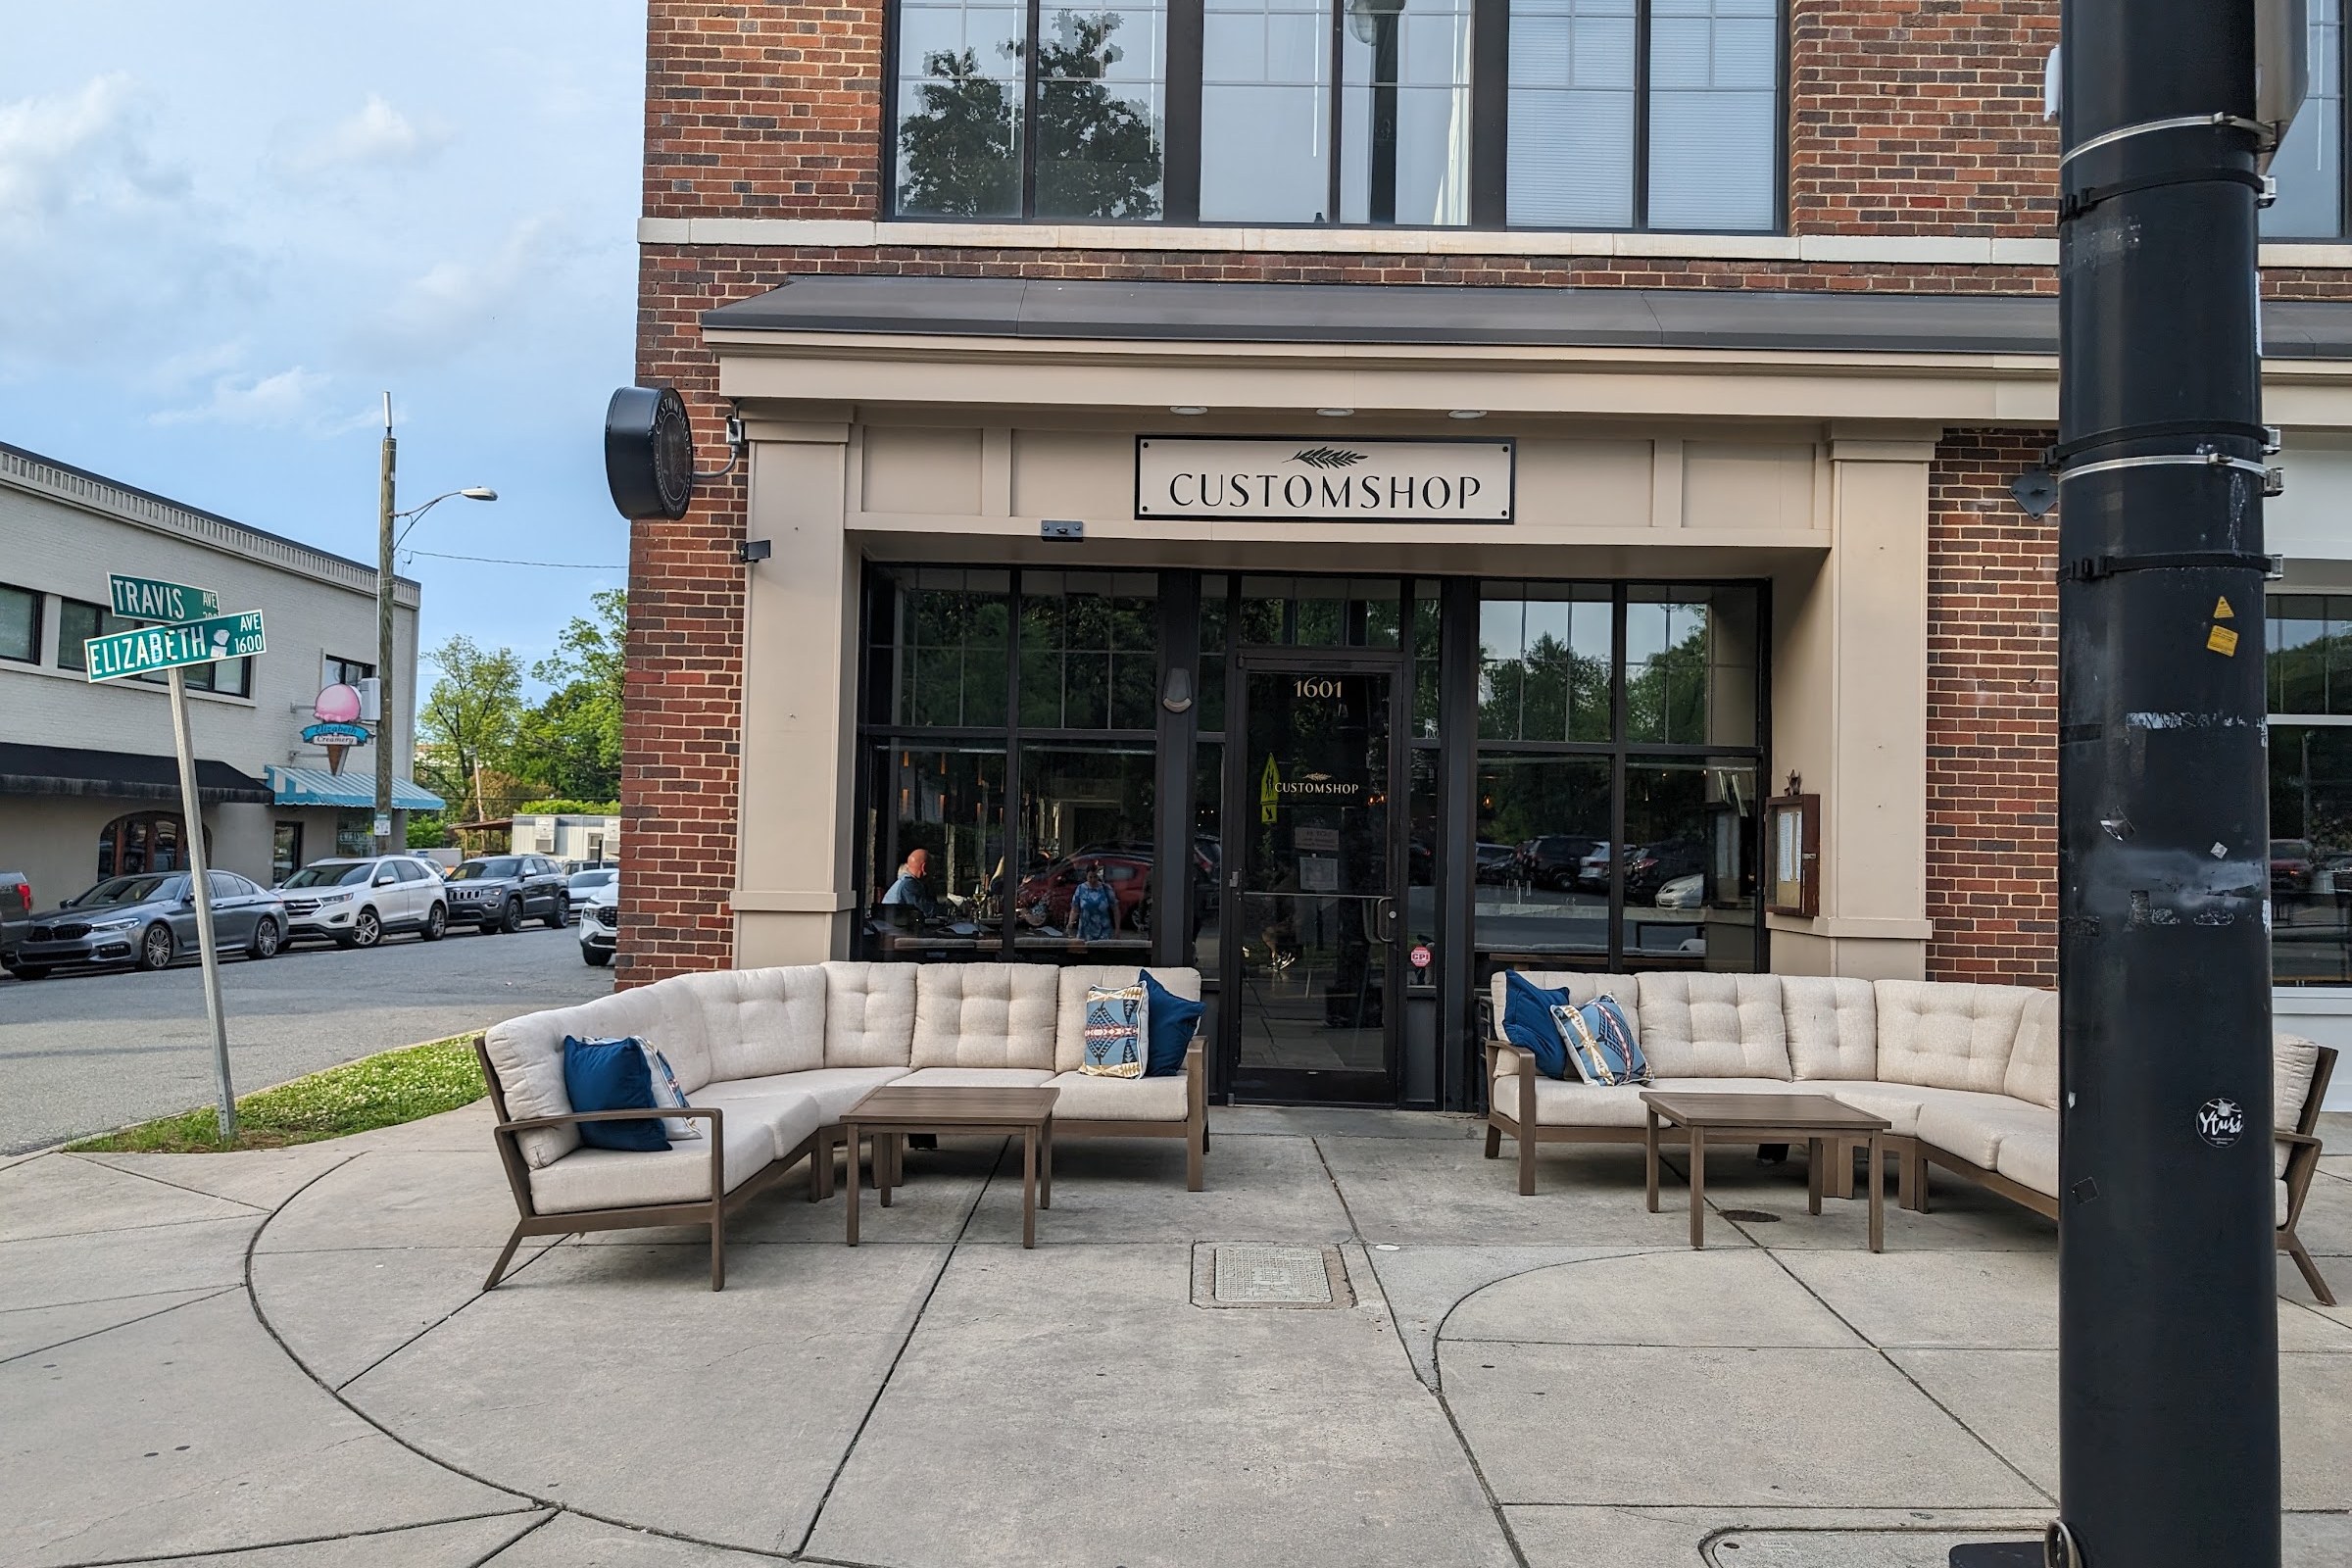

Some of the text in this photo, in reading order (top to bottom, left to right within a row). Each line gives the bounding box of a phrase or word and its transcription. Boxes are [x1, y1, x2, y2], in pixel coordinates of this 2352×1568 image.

[655, 397, 691, 454] CUSTOMSHOP
[1169, 473, 1481, 510] CUSTOMSHOP
[113, 580, 218, 619] TRAVIS AVE
[89, 613, 261, 675] ELIZABETH AVE
[234, 635, 263, 654] 1600
[1294, 677, 1342, 698] 1601
[316, 724, 358, 735] Elizabeth
[317, 735, 355, 744] Creamery
[1274, 782, 1359, 795] CUSTOMSHOP
[2199, 1110, 2243, 1136] Ytusi
